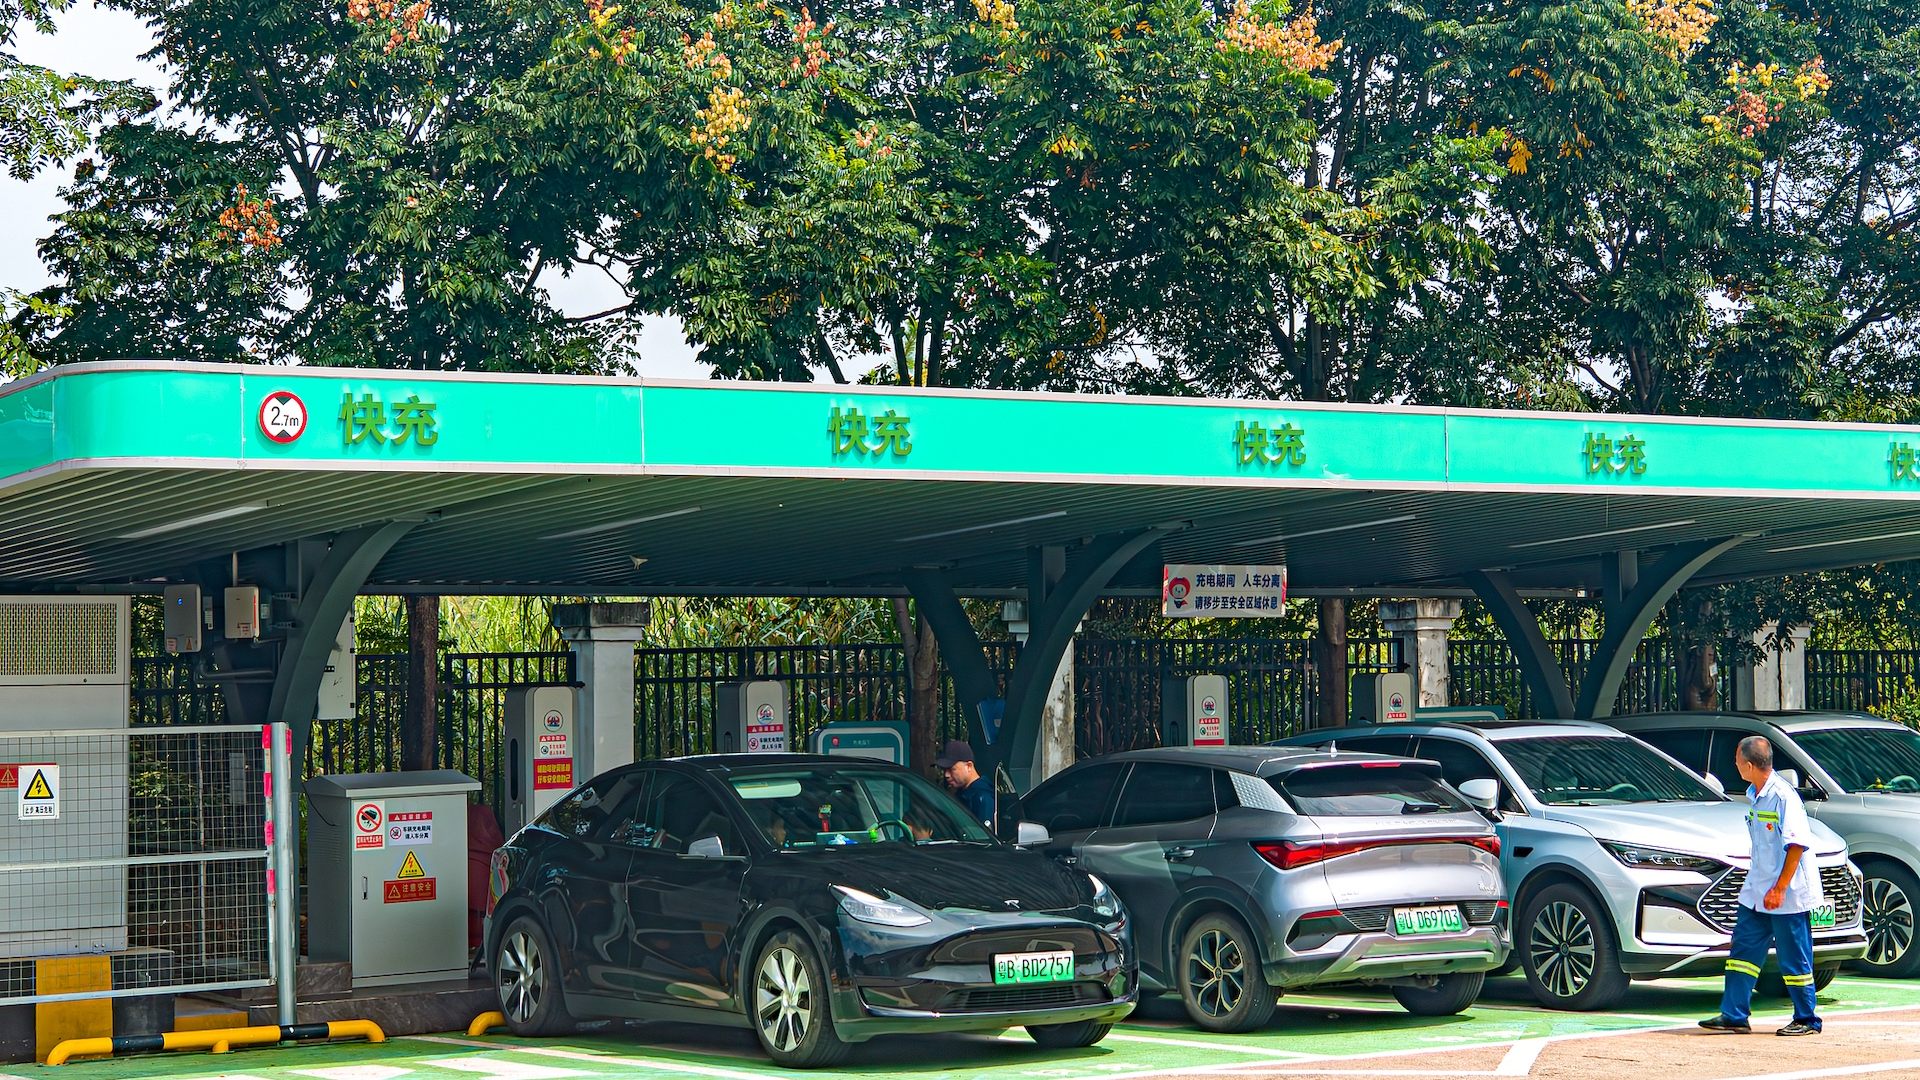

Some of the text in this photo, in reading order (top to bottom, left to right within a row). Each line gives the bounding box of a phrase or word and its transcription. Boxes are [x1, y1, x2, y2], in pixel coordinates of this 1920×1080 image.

[271, 406, 299, 427] 2.7m
[338, 393, 439, 446] 快充
[827, 406, 913, 456] 快充
[1232, 420, 1307, 466] 快充
[1582, 432, 1647, 475] 快充
[1887, 441, 1920, 481] 快
[1196, 573, 1281, 588] 充电期间 人车分离
[1195, 596, 1278, 610] 请移步至安全区域休息
